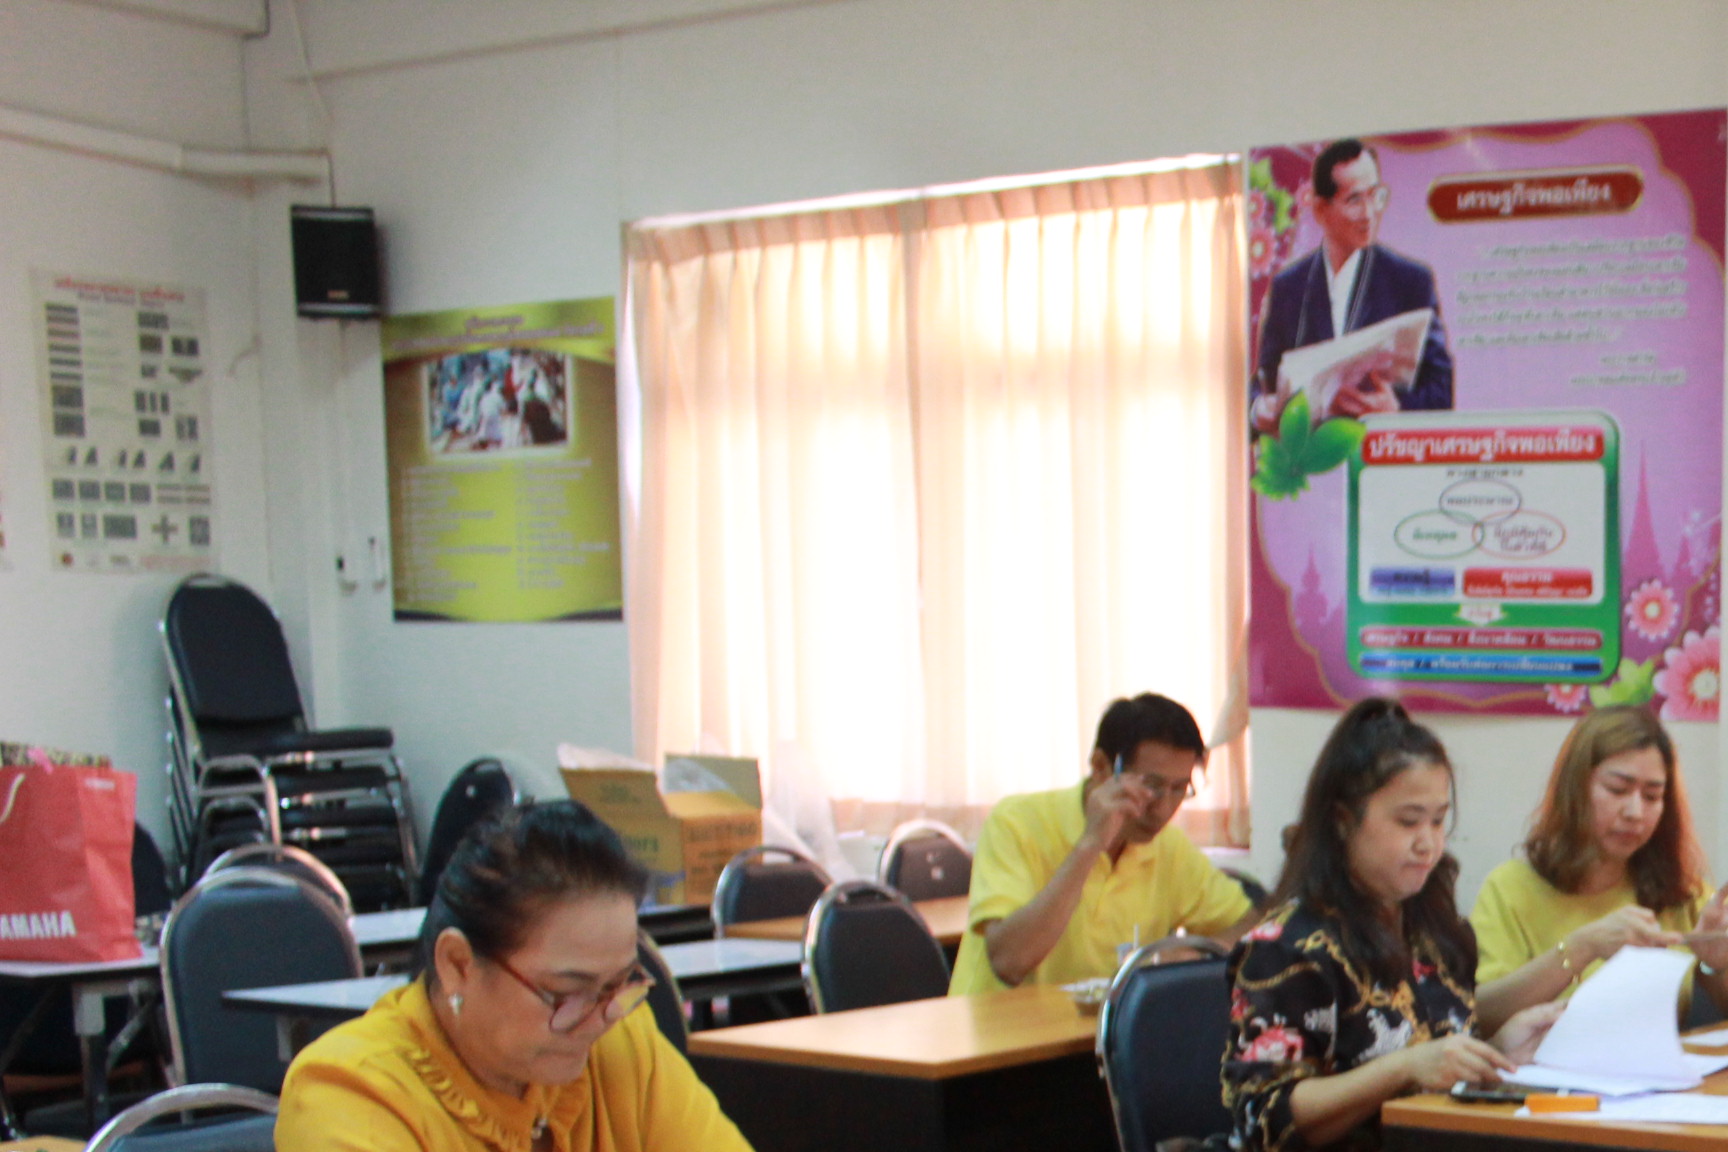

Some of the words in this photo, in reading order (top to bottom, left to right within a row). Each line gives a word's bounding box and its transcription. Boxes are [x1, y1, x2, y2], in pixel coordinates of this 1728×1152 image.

[1370, 429, 1594, 461] ปรัชญาเศรษฐกิจพอเพียง
[0, 909, 77, 939] AMAHA
